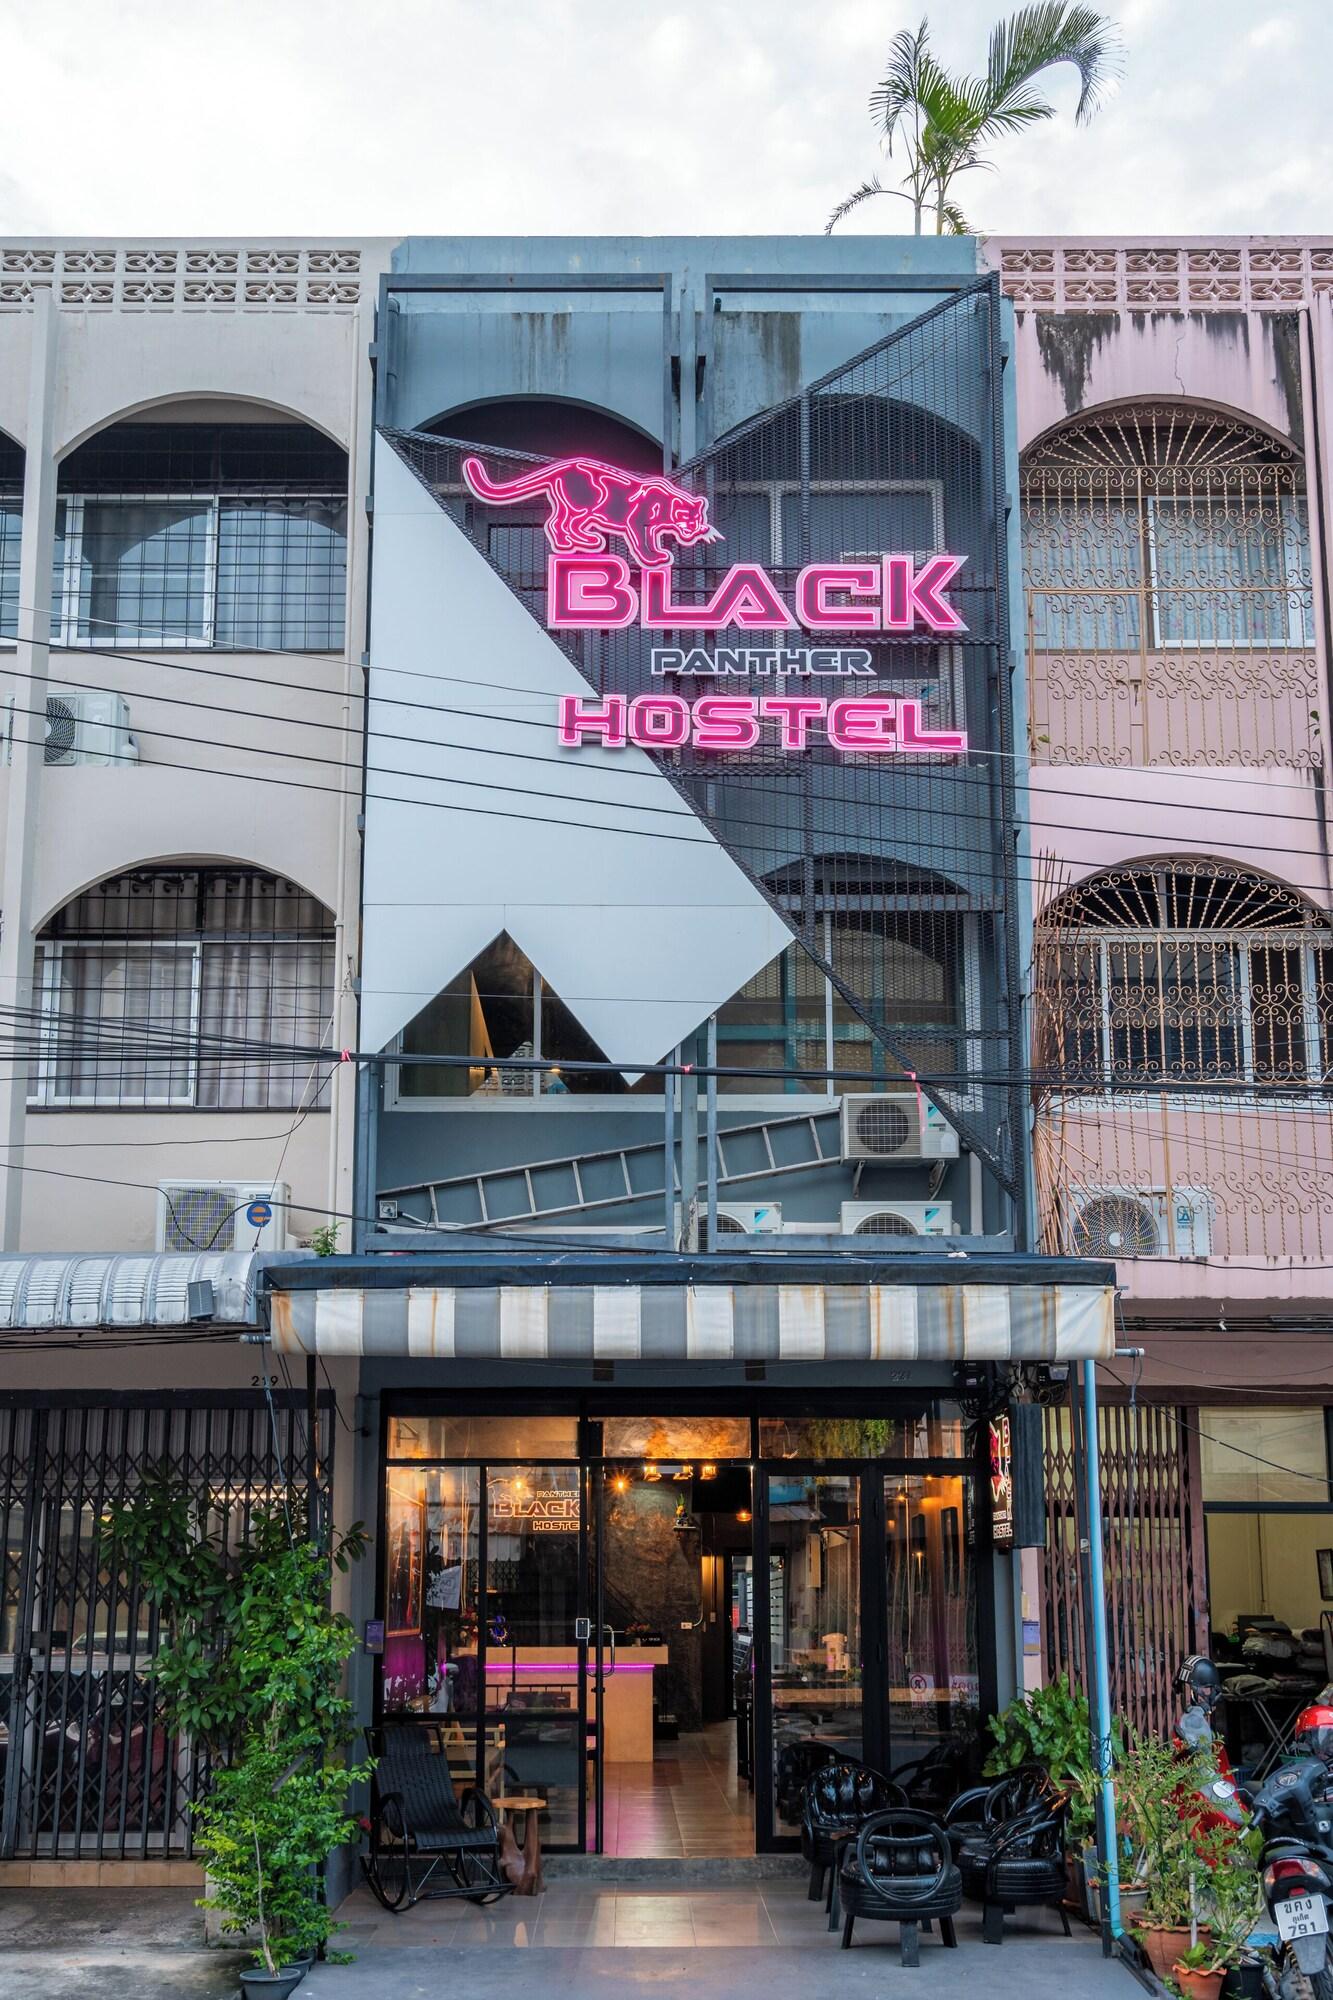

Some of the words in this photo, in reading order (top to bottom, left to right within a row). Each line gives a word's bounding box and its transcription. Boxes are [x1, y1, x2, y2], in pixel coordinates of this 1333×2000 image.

[547, 553, 968, 631] BLACK
[650, 648, 877, 676] PANTHER
[557, 694, 968, 753] HOSTEL
[536, 1490, 580, 1498] PANTHE
[494, 1499, 580, 1518] BLACK
[532, 1521, 580, 1531] HOSTE
[1288, 1921, 1316, 1937] 791
